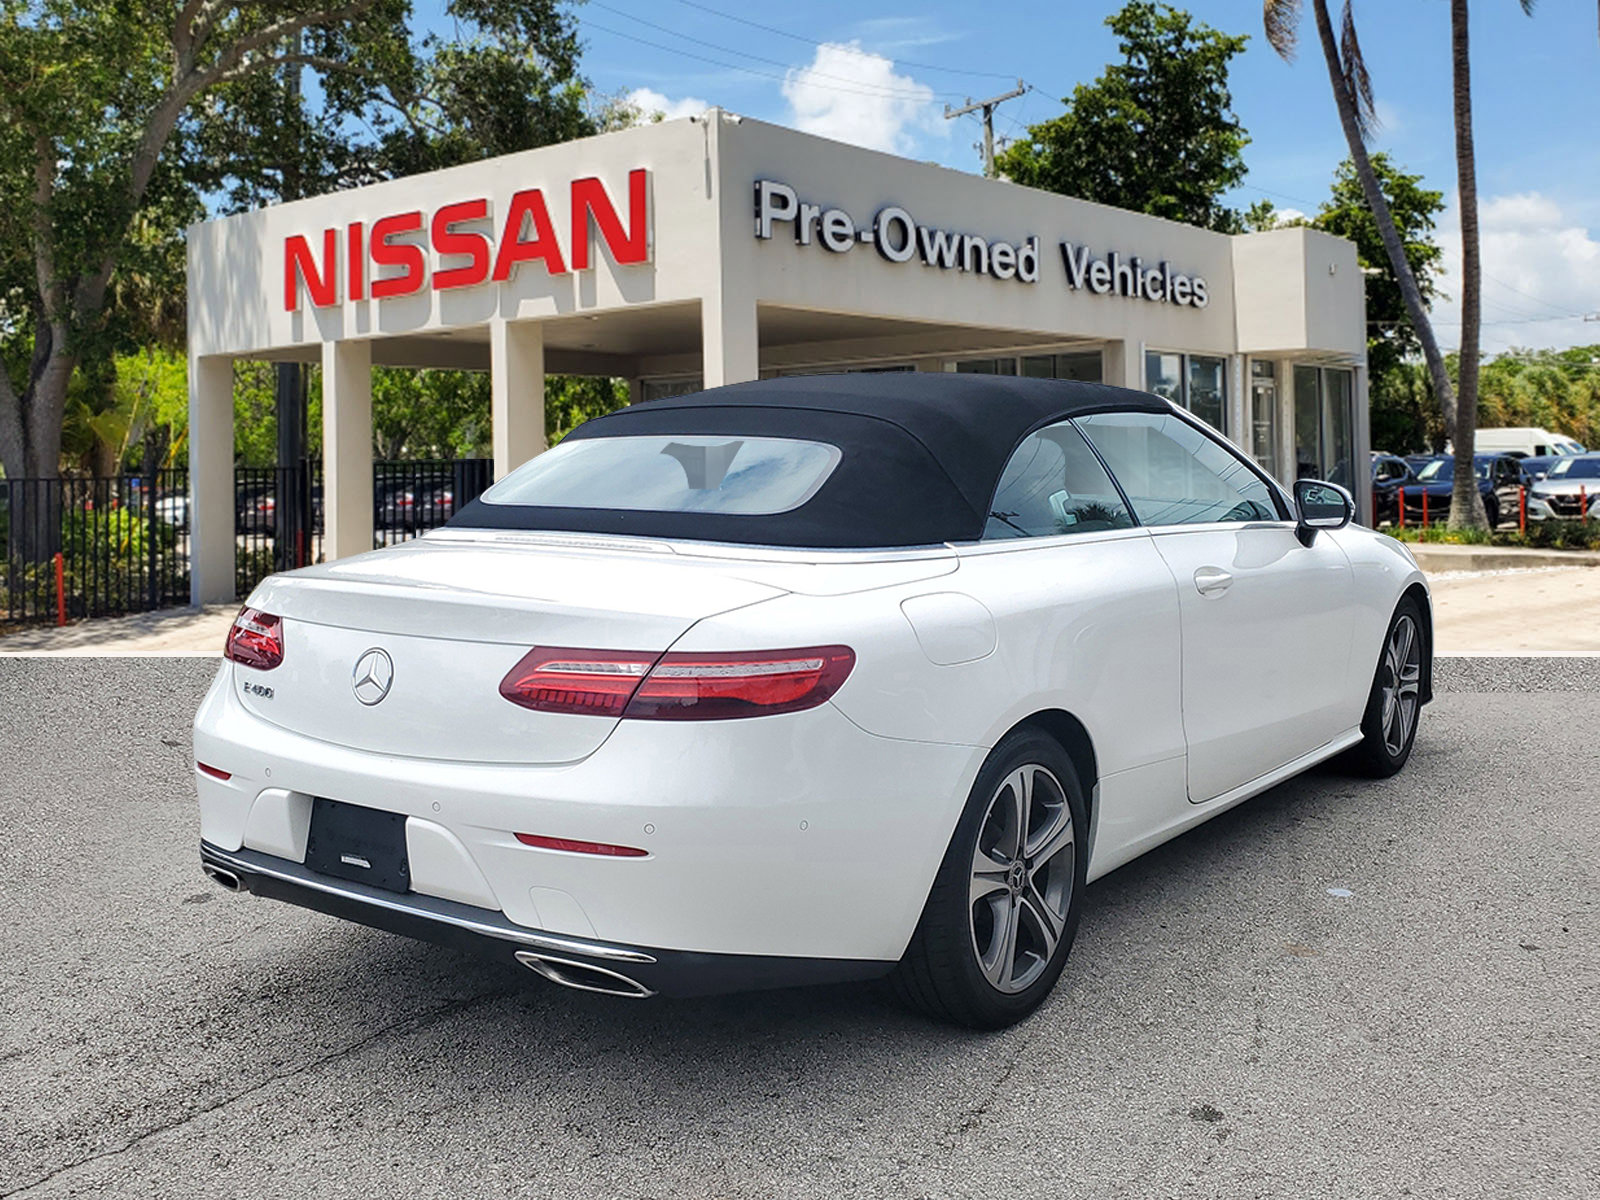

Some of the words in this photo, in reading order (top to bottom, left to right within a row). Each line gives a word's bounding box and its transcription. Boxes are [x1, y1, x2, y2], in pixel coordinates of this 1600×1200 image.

[285, 168, 647, 312] NISSAN
[755, 180, 1039, 283] Pre-Owned
[1060, 241, 1209, 308] Vehicles
